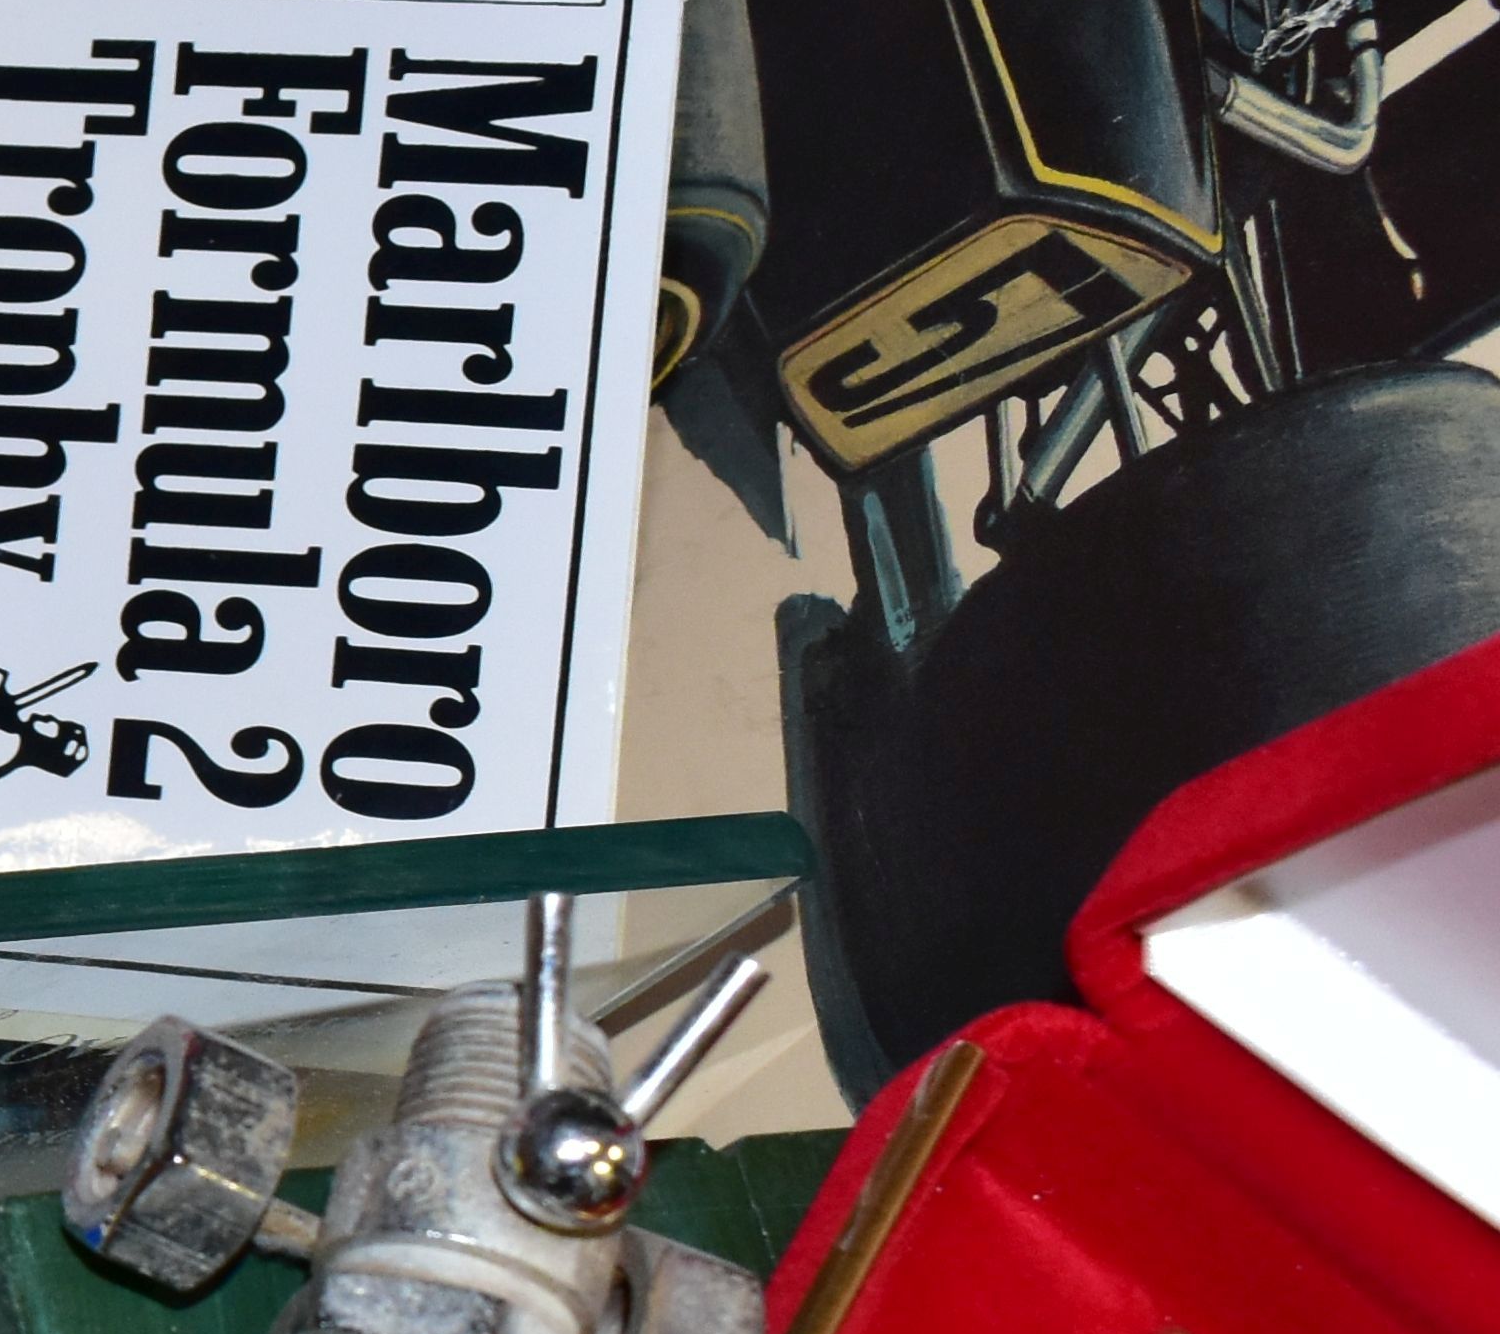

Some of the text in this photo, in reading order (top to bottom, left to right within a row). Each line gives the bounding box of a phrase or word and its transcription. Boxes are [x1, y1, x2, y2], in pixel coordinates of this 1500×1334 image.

[107, 41, 369, 809] Formula 2
[319, 49, 599, 821] Marlboro
